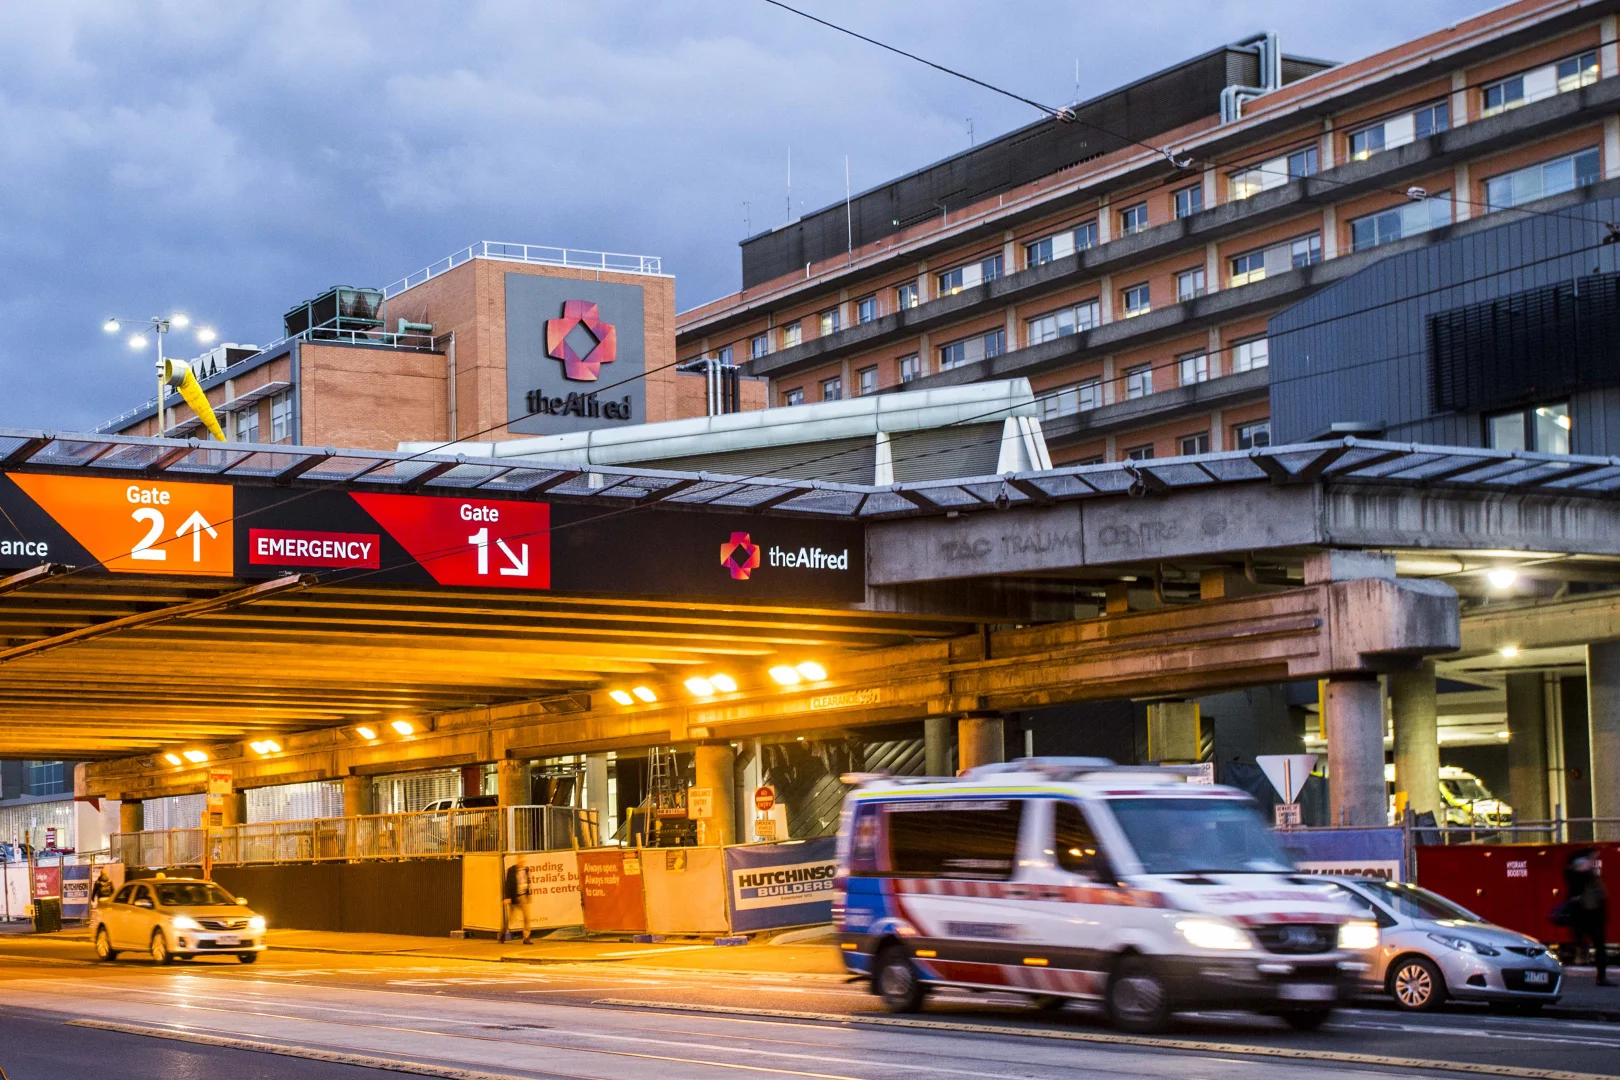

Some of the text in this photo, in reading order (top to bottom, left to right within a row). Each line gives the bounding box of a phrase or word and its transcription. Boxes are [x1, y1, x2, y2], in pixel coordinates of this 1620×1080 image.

[525, 389, 632, 420] theAlfred
[126, 485, 171, 505] Gate
[460, 504, 499, 522] Gate
[131, 507, 167, 561] 2
[257, 537, 372, 560] EMERGENCY
[468, 527, 488, 575] 1
[768, 545, 848, 570] theAlfred
[567, 872, 580, 881] bu
[584, 863, 603, 873] Always
[738, 865, 837, 888] HUTCHINSO
[585, 875, 620, 886] Always ready
[757, 881, 834, 897] BUILDERS
[528, 887, 548, 896] uma
[586, 888, 592, 896] to
